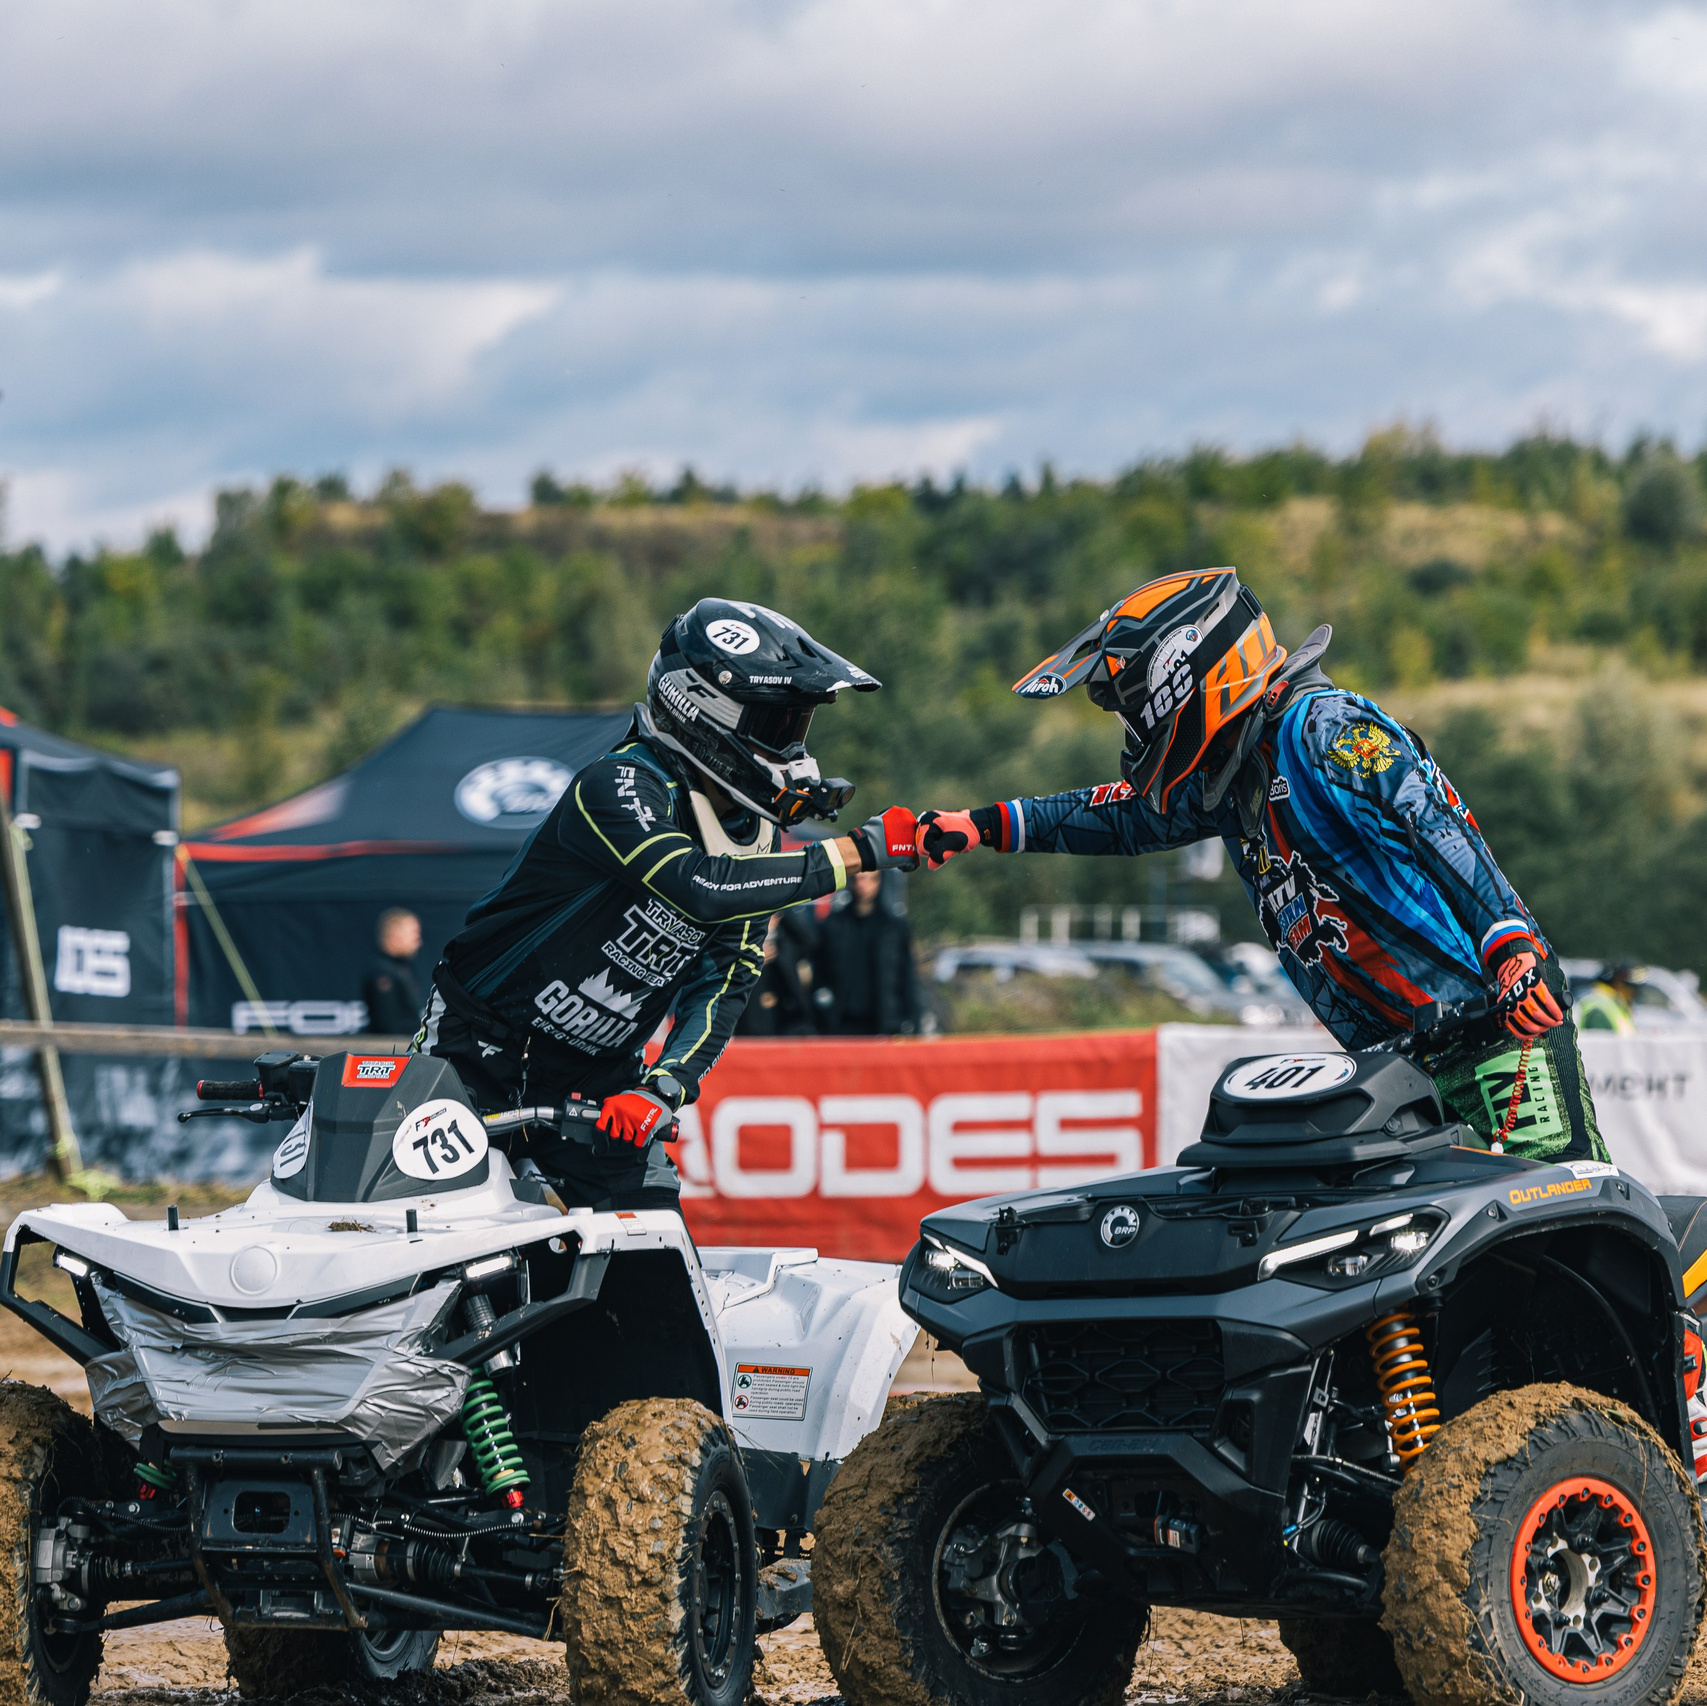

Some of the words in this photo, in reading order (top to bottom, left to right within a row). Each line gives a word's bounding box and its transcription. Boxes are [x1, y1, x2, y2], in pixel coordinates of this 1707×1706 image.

[712, 626, 750, 650] 731
[720, 883, 742, 892] FOR
[601, 940, 646, 980] RACING
[357, 1065, 396, 1076] TRT
[1244, 1066, 1326, 1090] 401
[1528, 1066, 1551, 1124] RACING
[412, 1119, 474, 1175] 731
[1509, 1179, 1592, 1204] OUTLANDER
[1114, 1226, 1136, 1234] BRP
[762, 1366, 795, 1375] WARNING
